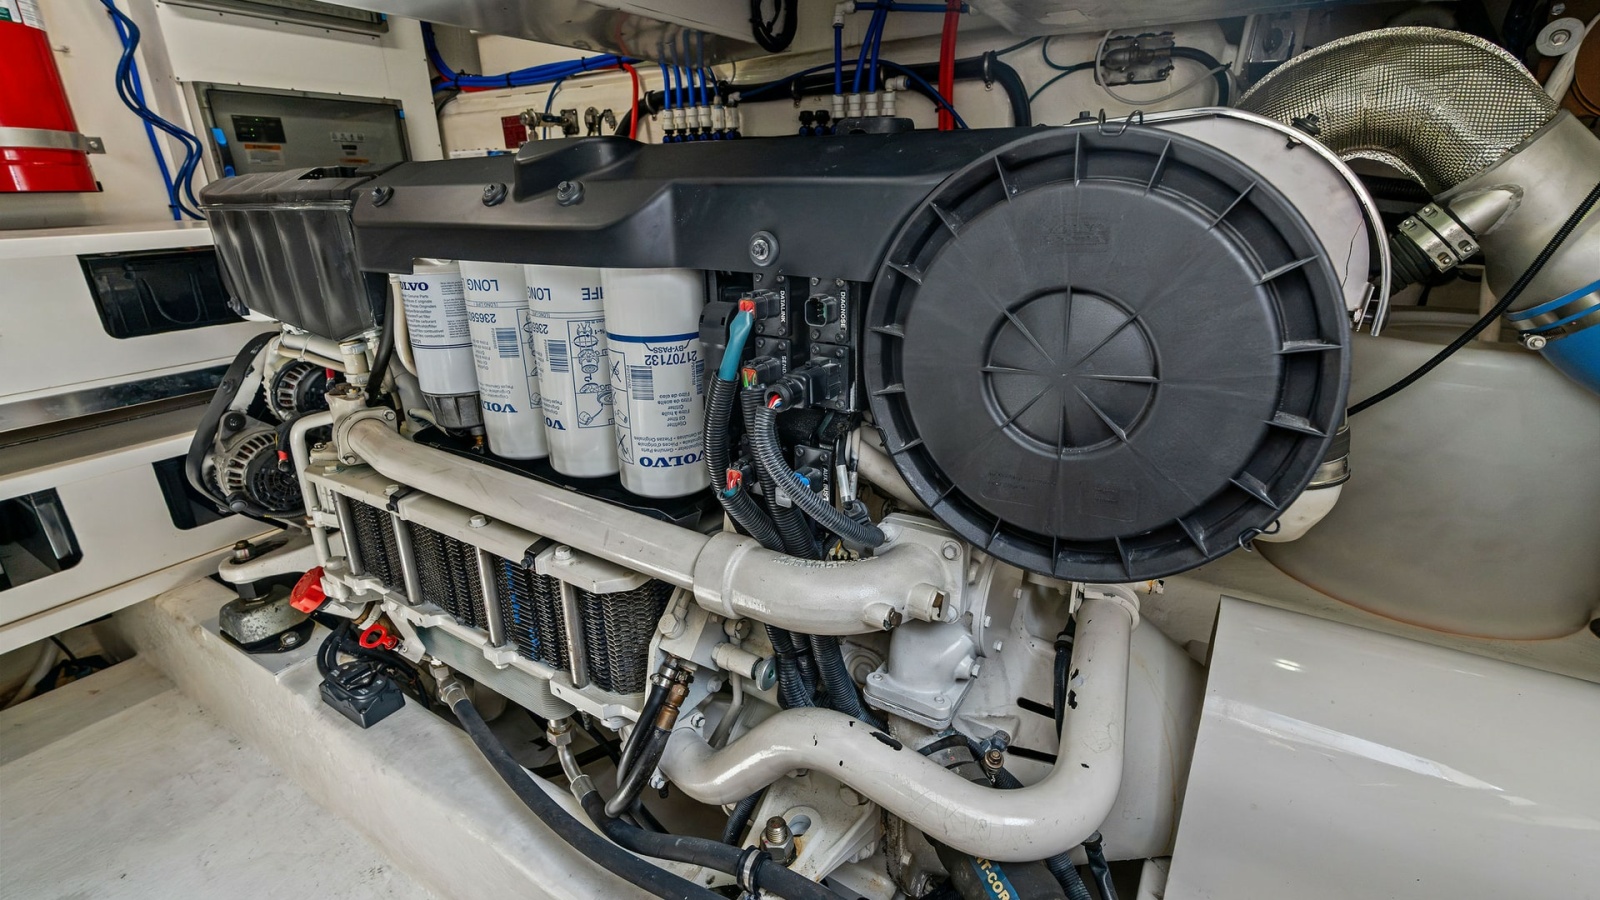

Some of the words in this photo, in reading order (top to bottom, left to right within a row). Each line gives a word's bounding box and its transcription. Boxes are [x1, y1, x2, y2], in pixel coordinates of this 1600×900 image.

[467, 279, 498, 292] LONG
[581, 287, 603, 301] IFE
[840, 291, 848, 329] DIAGNOSE
[653, 345, 684, 353] BY-PASS
[645, 351, 697, 367] 21707132
[544, 416, 566, 431] VO
